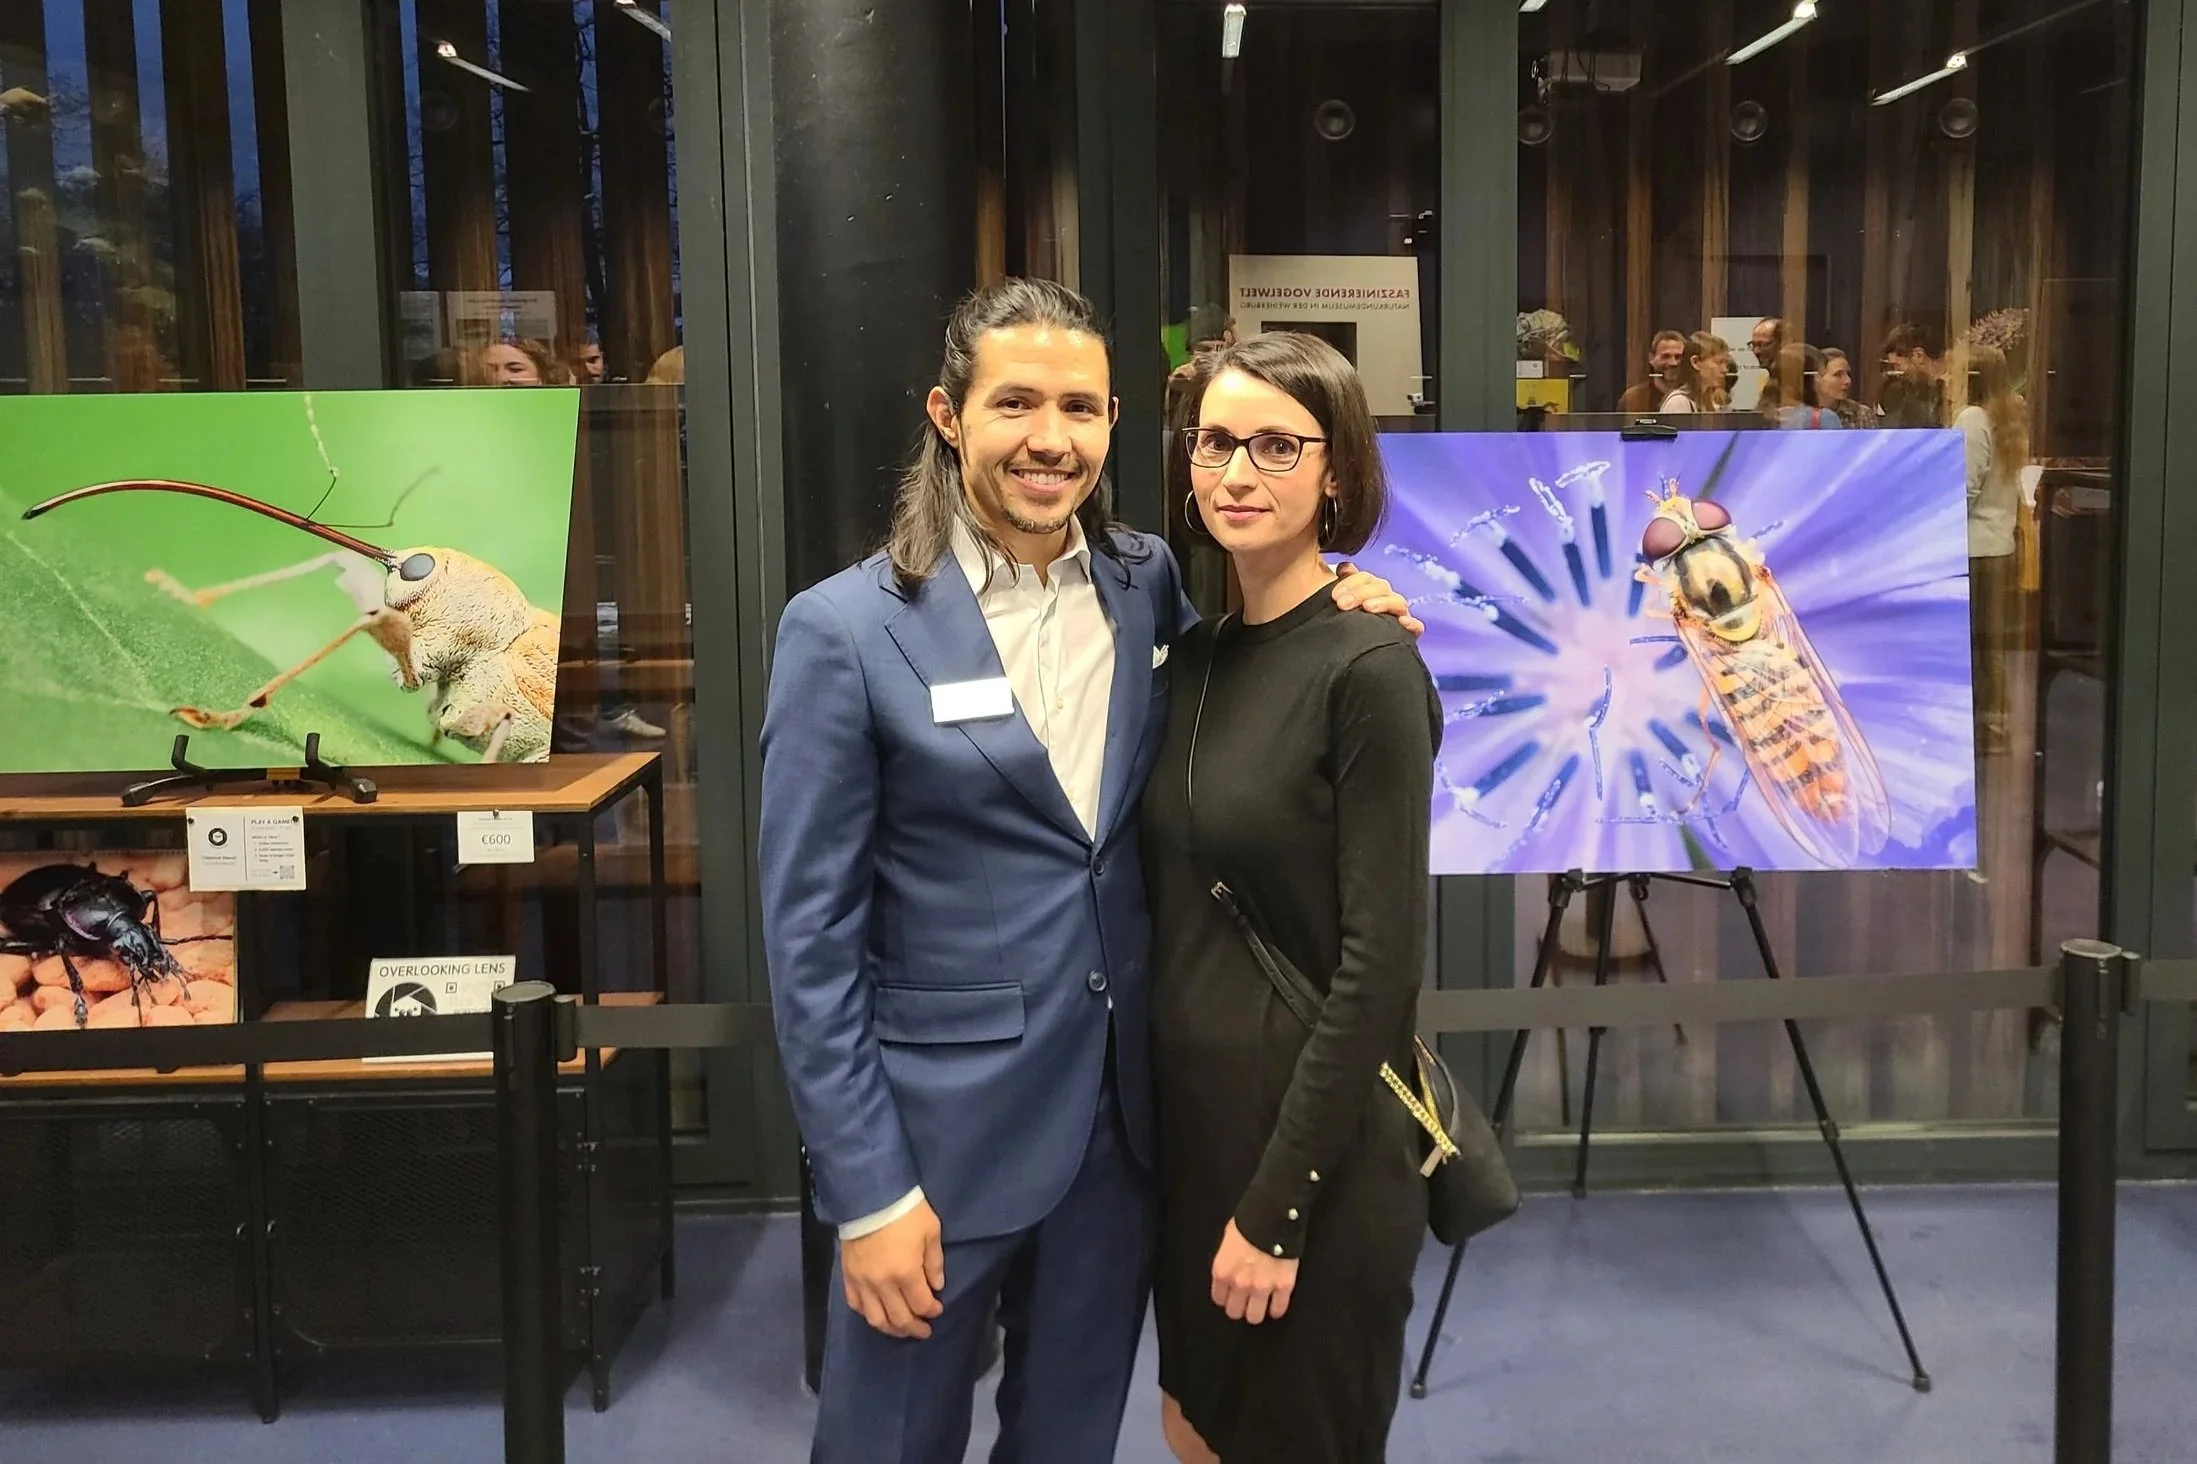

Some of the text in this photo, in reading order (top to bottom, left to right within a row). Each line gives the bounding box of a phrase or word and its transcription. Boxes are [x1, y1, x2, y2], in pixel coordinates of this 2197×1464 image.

[481, 834, 511, 845] €600
[379, 962, 506, 978] OVERLOOKING LENS
